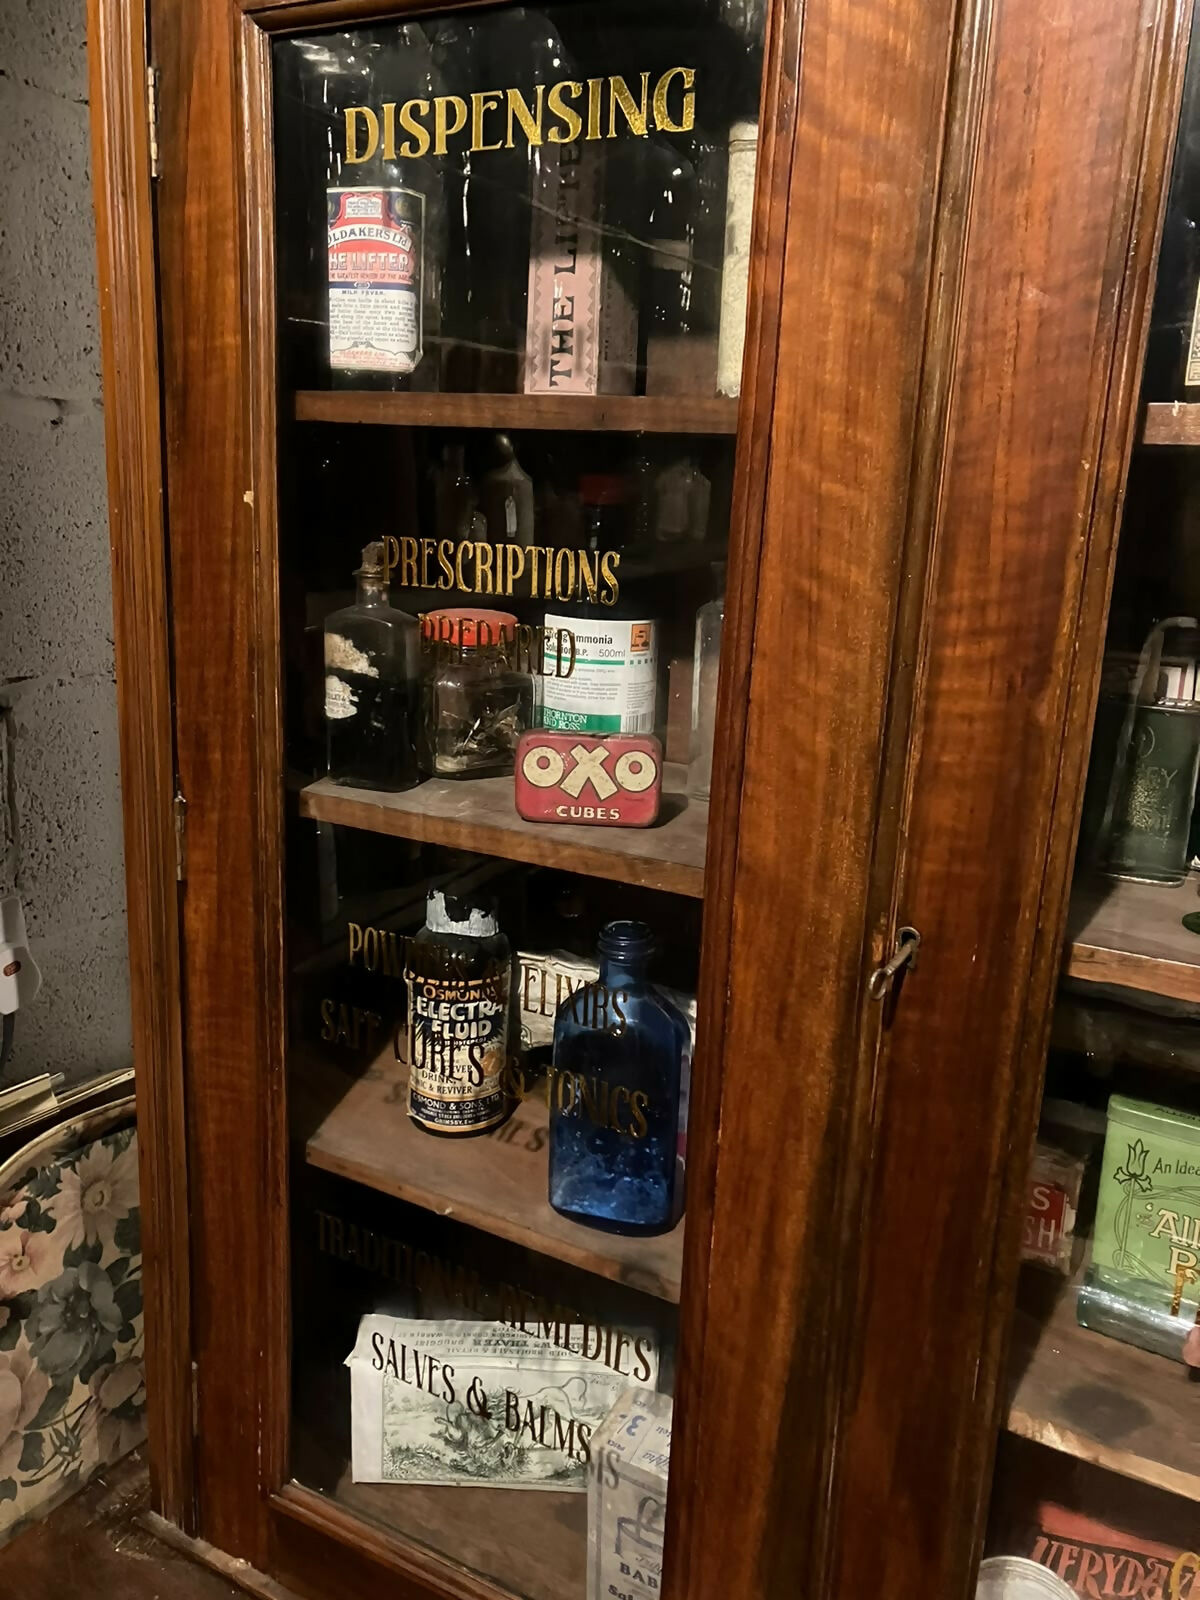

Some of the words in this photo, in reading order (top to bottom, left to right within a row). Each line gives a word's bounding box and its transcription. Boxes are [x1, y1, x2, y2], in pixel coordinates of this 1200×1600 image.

[344, 67, 697, 164] DISPENSING
[553, 138, 581, 276] LIFTE
[352, 253, 409, 272] LIFTER
[548, 295, 575, 388] THE
[381, 535, 620, 607] PRESCRIPTIONS
[417, 613, 577, 678] PREPARED
[573, 633, 613, 645] mmonia
[598, 649, 626, 659] 500ml
[544, 708, 588, 725] THORNTON
[558, 720, 582, 731] ROSS
[522, 742, 658, 802] OXO
[556, 804, 621, 821] CUBES
[522, 963, 628, 1037] ELIXIRS
[431, 1019, 492, 1040] FLUID
[437, 1086, 472, 1094] REVIVER
[449, 1102, 457, 1111] &
[545, 1065, 649, 1140] TONICS
[1152, 1157, 1172, 1174] An
[473, 1339, 528, 1347] THAYER
[496, 1280, 653, 1382] REMEDIES
[371, 1331, 456, 1405] SALVES
[466, 1375, 492, 1421] &
[505, 1391, 593, 1466] BALMS
